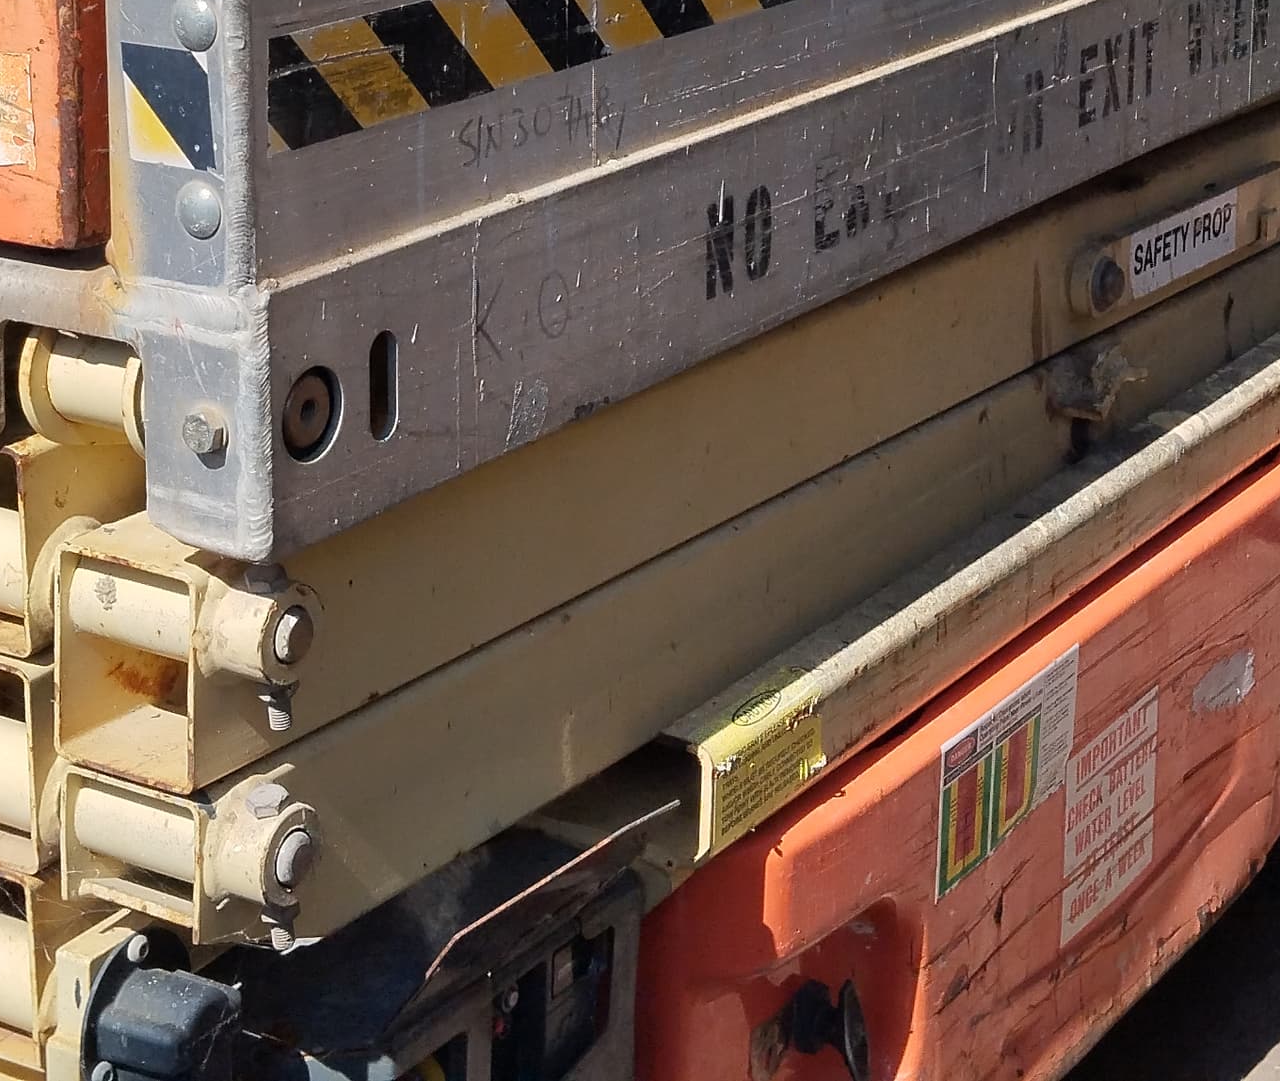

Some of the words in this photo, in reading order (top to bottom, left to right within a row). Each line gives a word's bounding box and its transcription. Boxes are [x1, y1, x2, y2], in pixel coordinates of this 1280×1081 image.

[705, 183, 773, 300] NO
[1078, 21, 1159, 128] EXIT
[1133, 221, 1190, 275] SAFETY
[1192, 202, 1232, 249] PROP
[1076, 706, 1149, 785] IMPORTANT
[1067, 783, 1104, 833] CHECK
[1074, 804, 1112, 858] WATER
[1116, 774, 1147, 818] LEVEL
